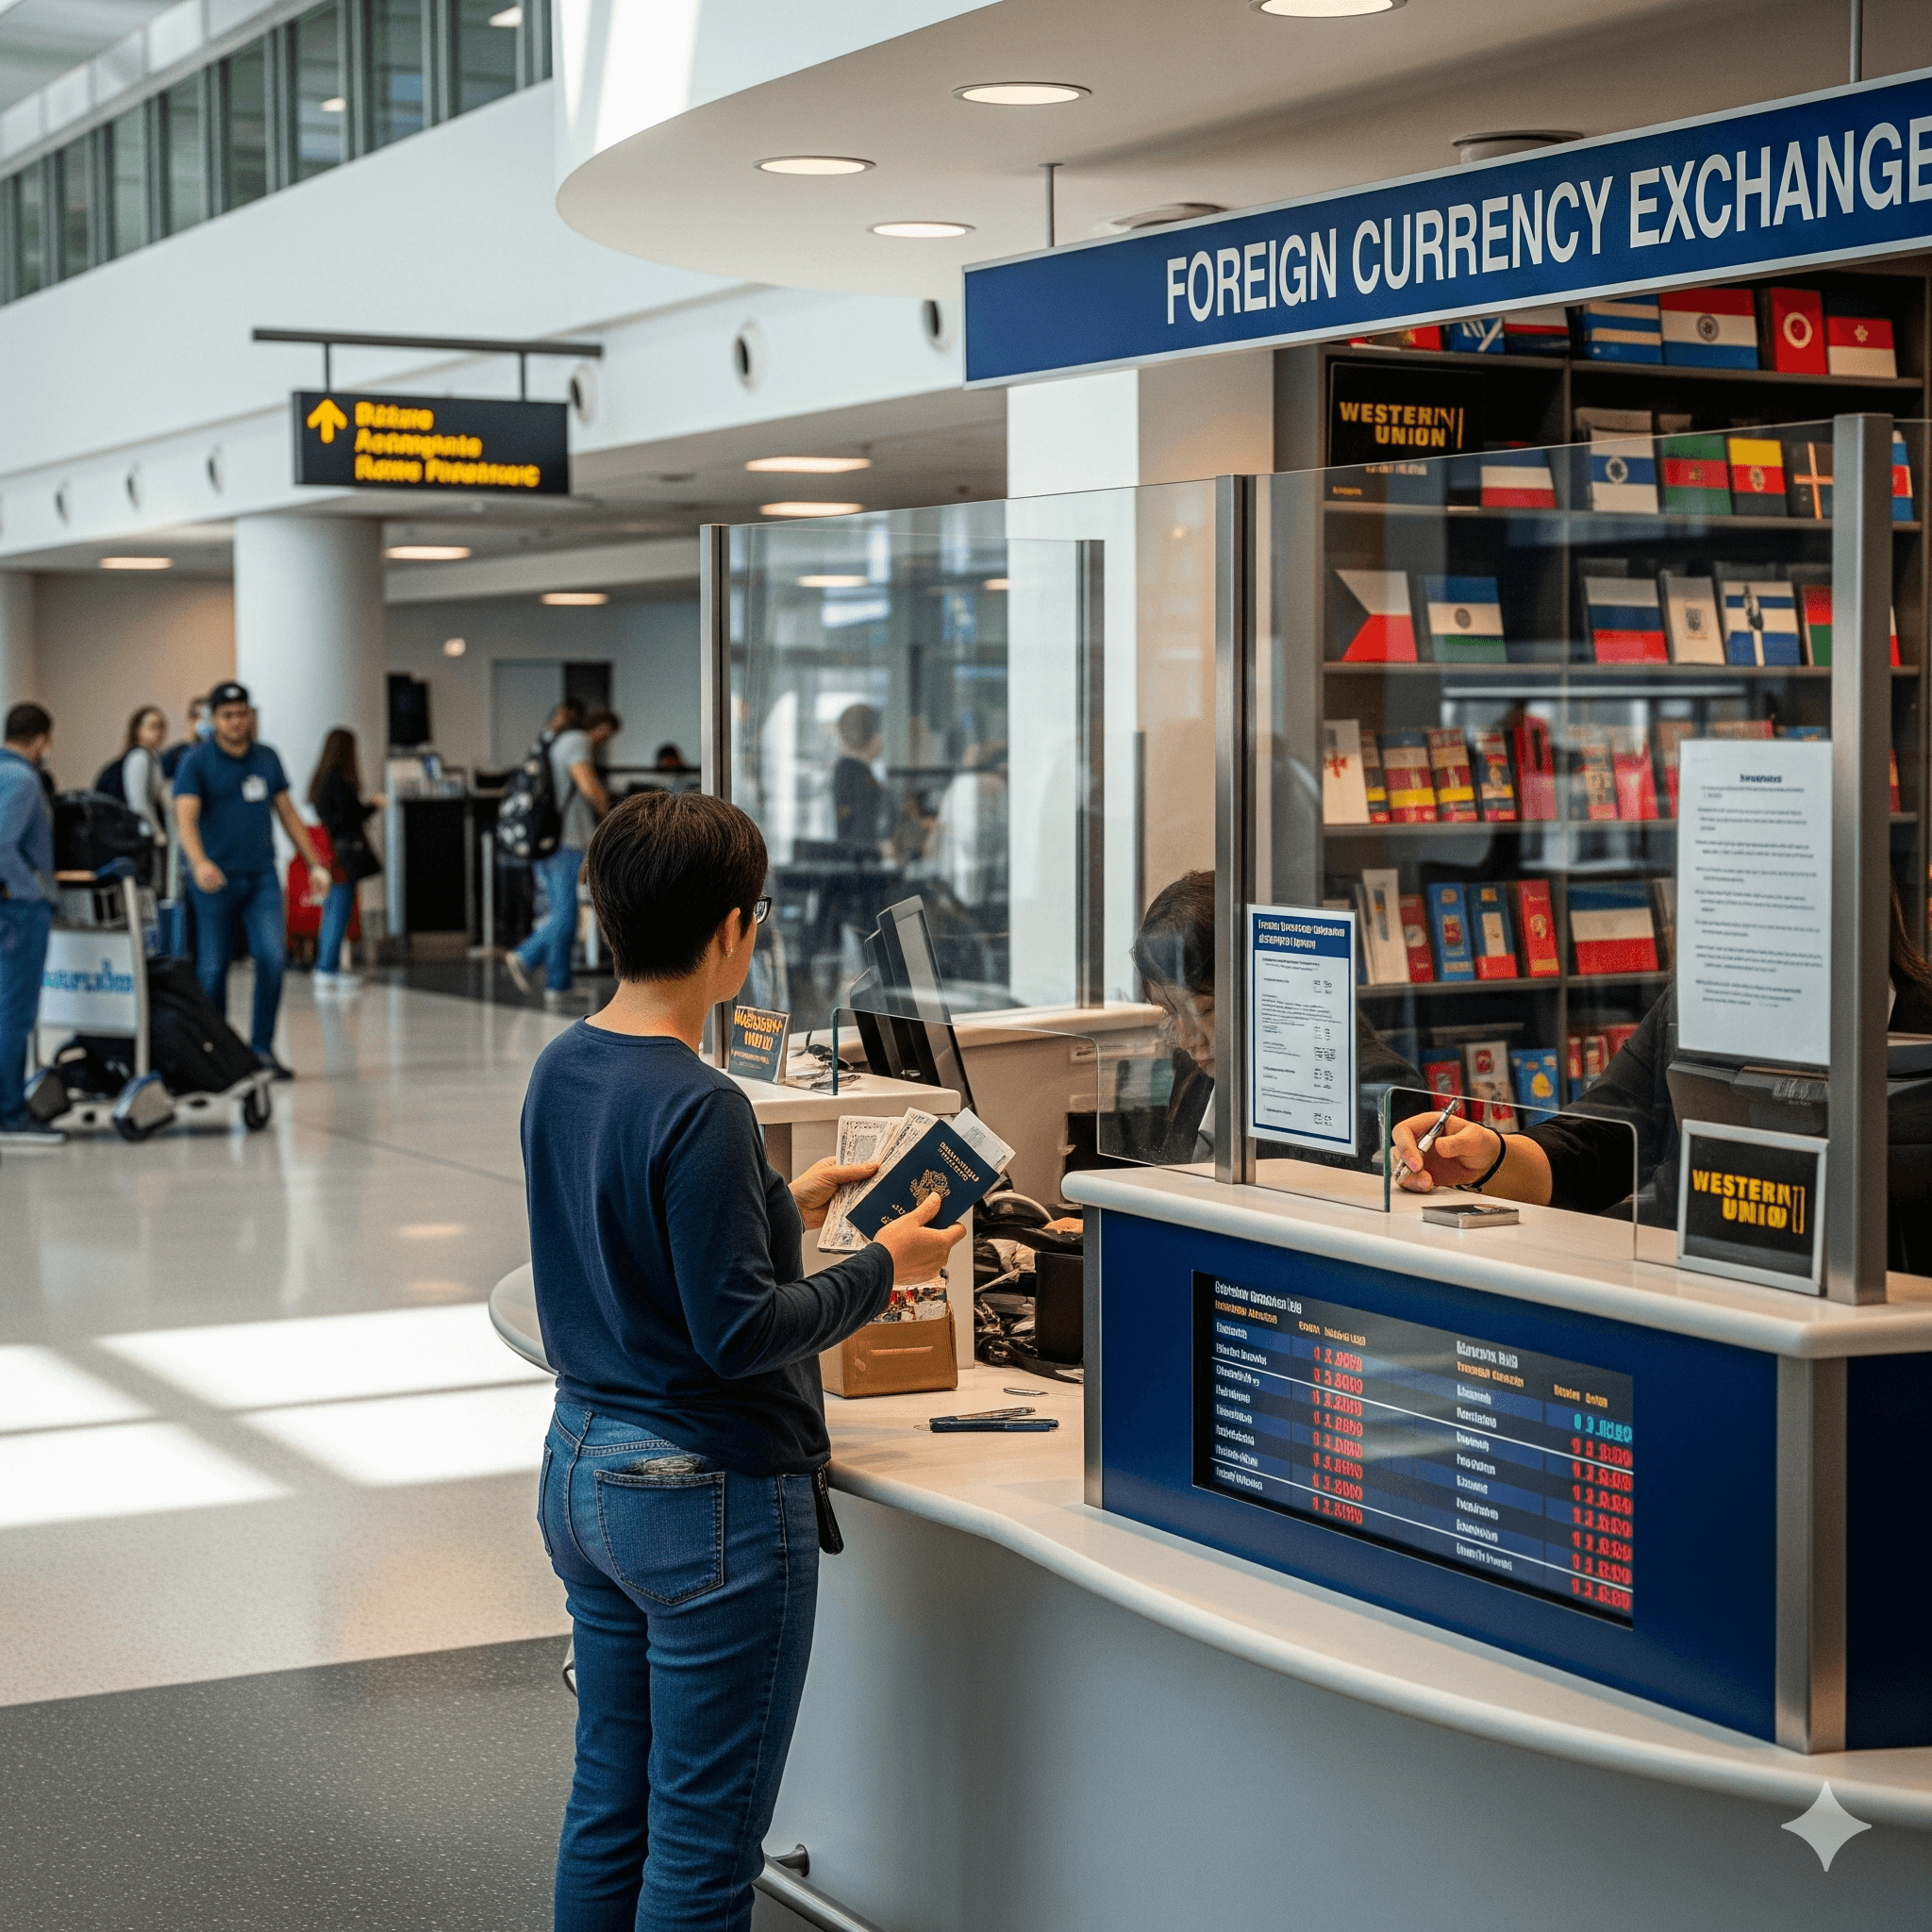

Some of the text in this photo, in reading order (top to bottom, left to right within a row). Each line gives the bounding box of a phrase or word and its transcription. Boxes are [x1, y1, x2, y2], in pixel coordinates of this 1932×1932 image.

[1167, 115, 1932, 325] FOREIGN CURRENCY EXCHANGE
[1339, 401, 1456, 431] WESTERN
[1374, 425, 1446, 447] UNION
[1691, 1169, 1791, 1208] WESTERN
